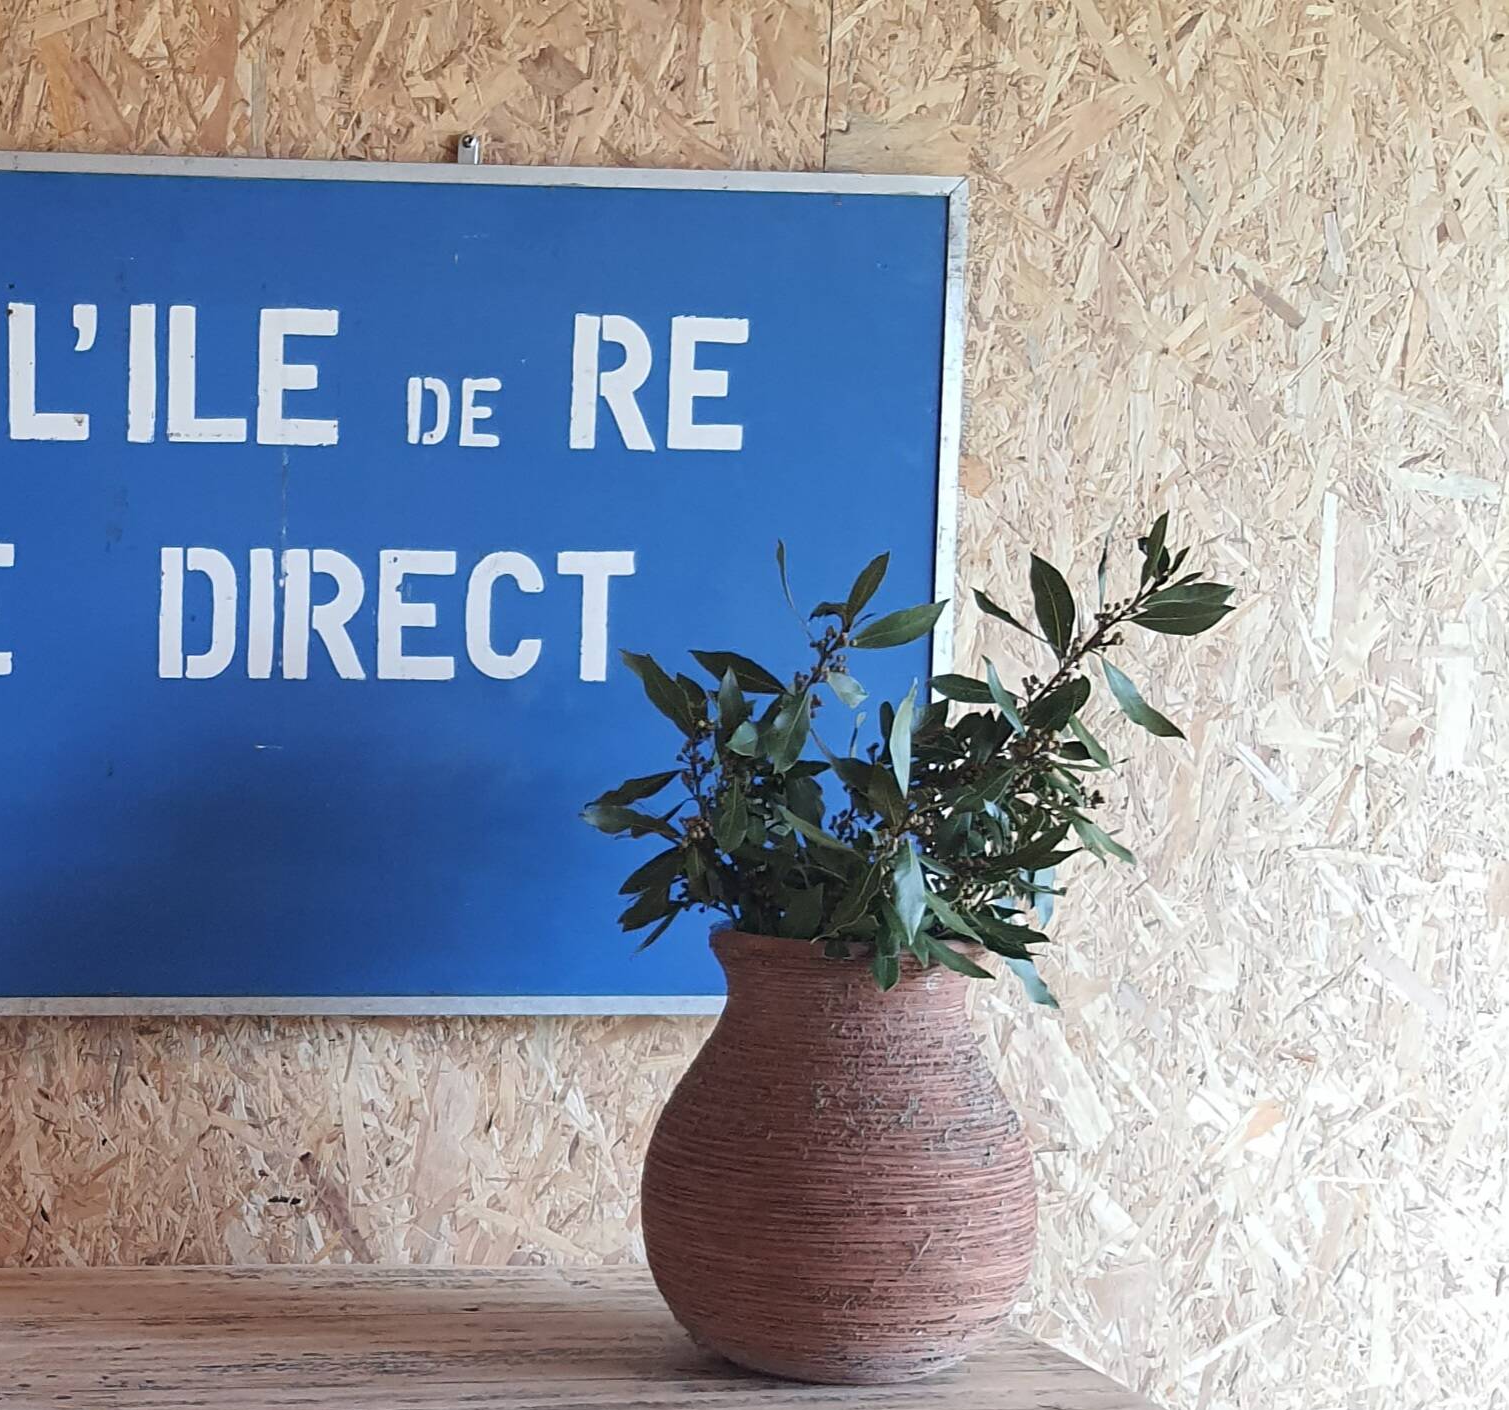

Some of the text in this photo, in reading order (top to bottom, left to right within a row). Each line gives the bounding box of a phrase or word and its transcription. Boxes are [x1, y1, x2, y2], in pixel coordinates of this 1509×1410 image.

[406, 375, 503, 448] DE
[569, 312, 751, 452] RE
[158, 546, 636, 682] DIRECT
